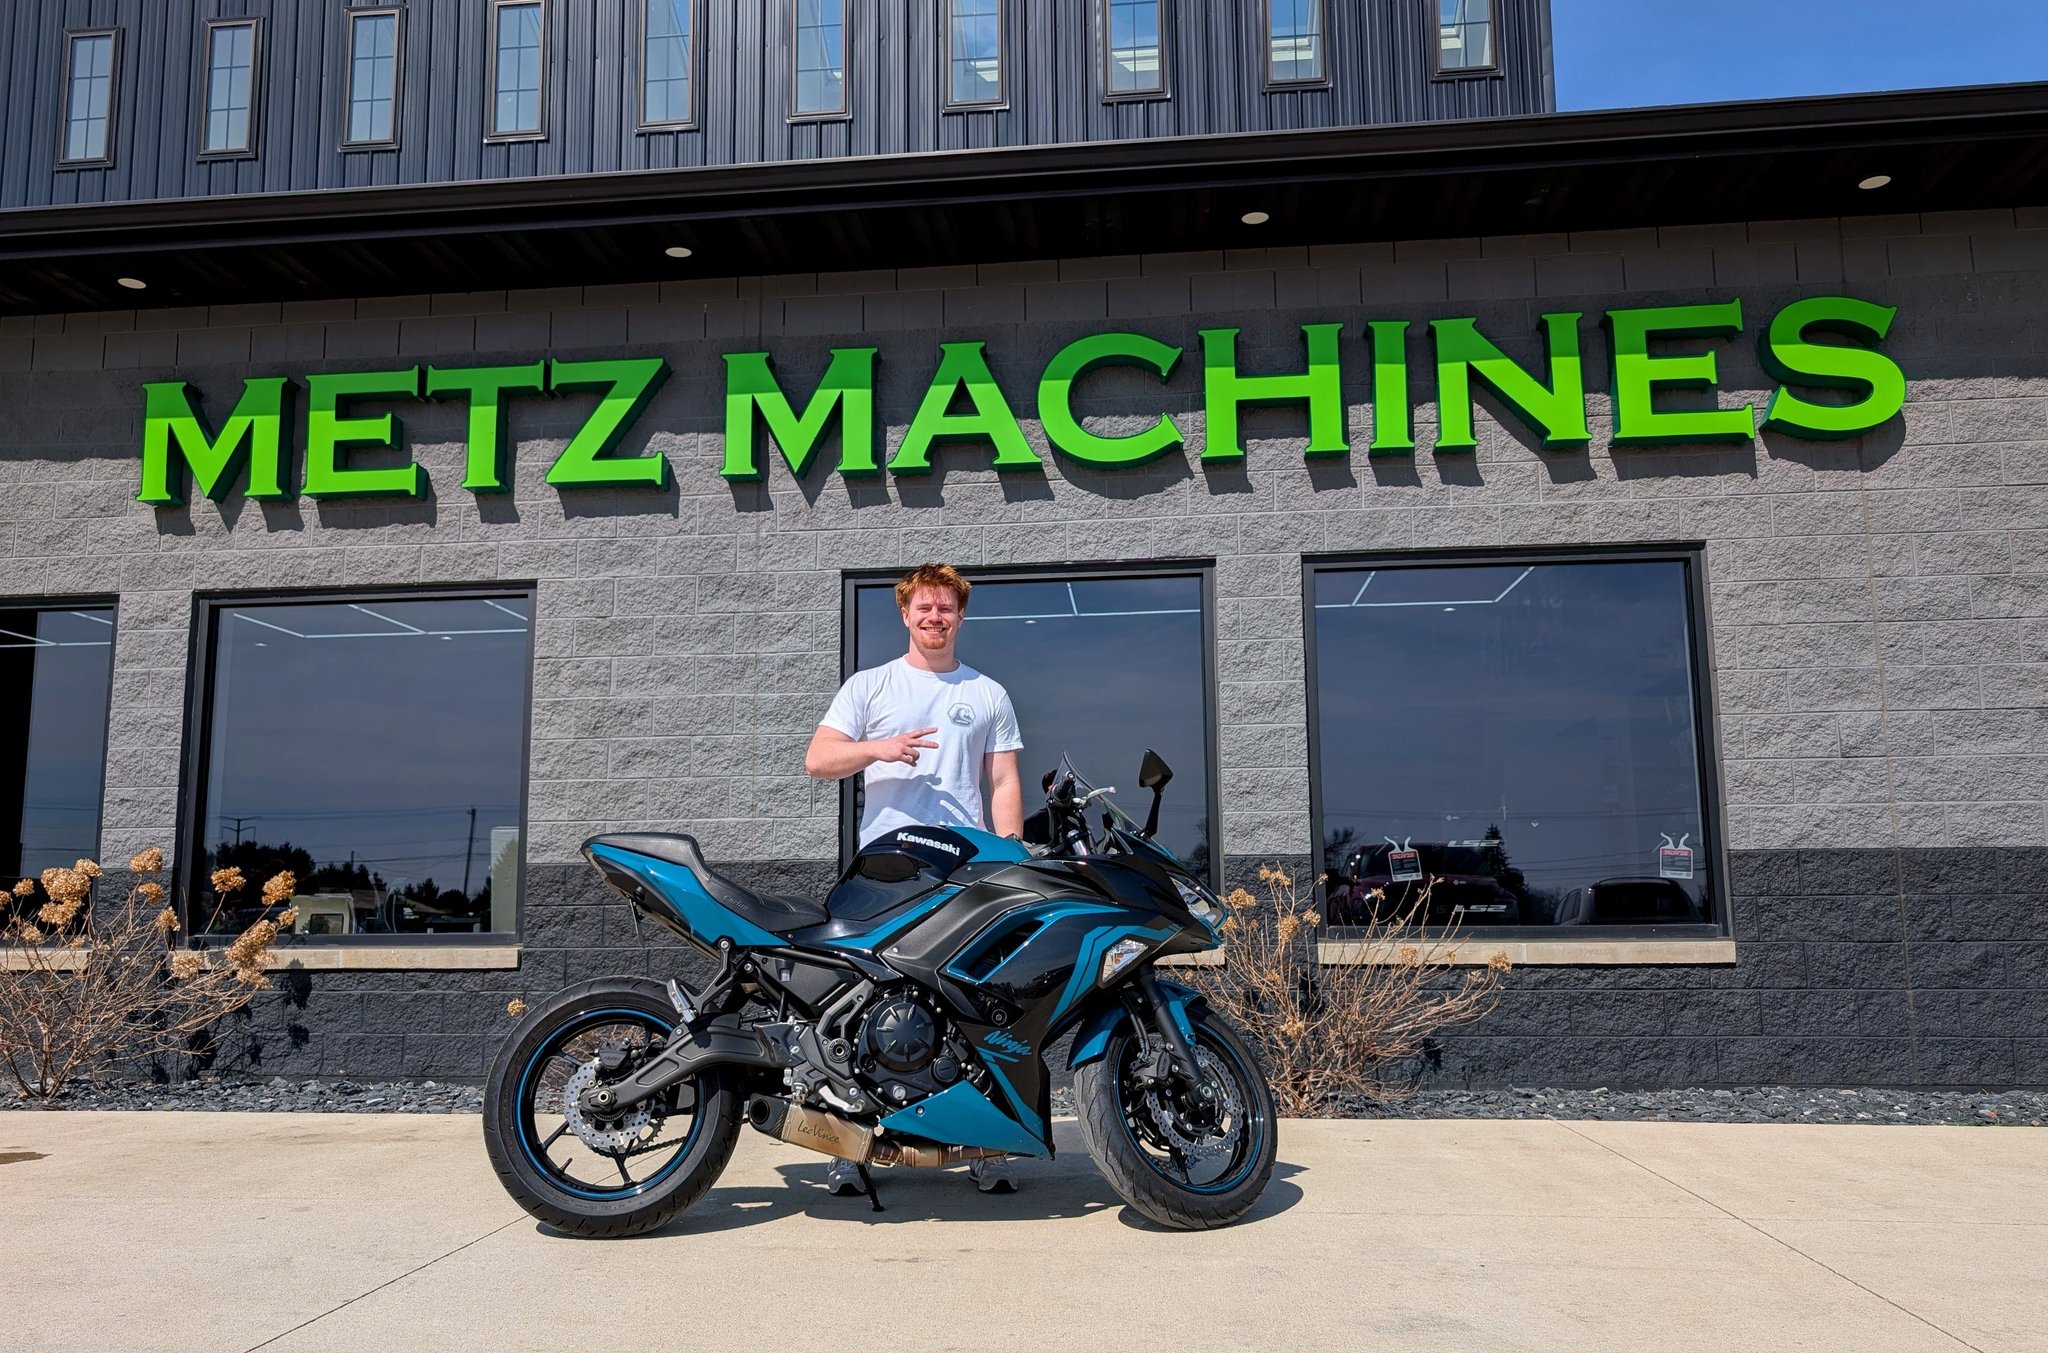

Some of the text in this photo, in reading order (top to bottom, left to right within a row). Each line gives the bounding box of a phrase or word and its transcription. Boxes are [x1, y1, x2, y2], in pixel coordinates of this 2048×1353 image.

[136, 297, 1908, 503] METZ MACHINES
[897, 832, 960, 856] Kawasaki
[984, 1030, 1032, 1055] Ninja
[797, 1119, 840, 1144] LeoVince
